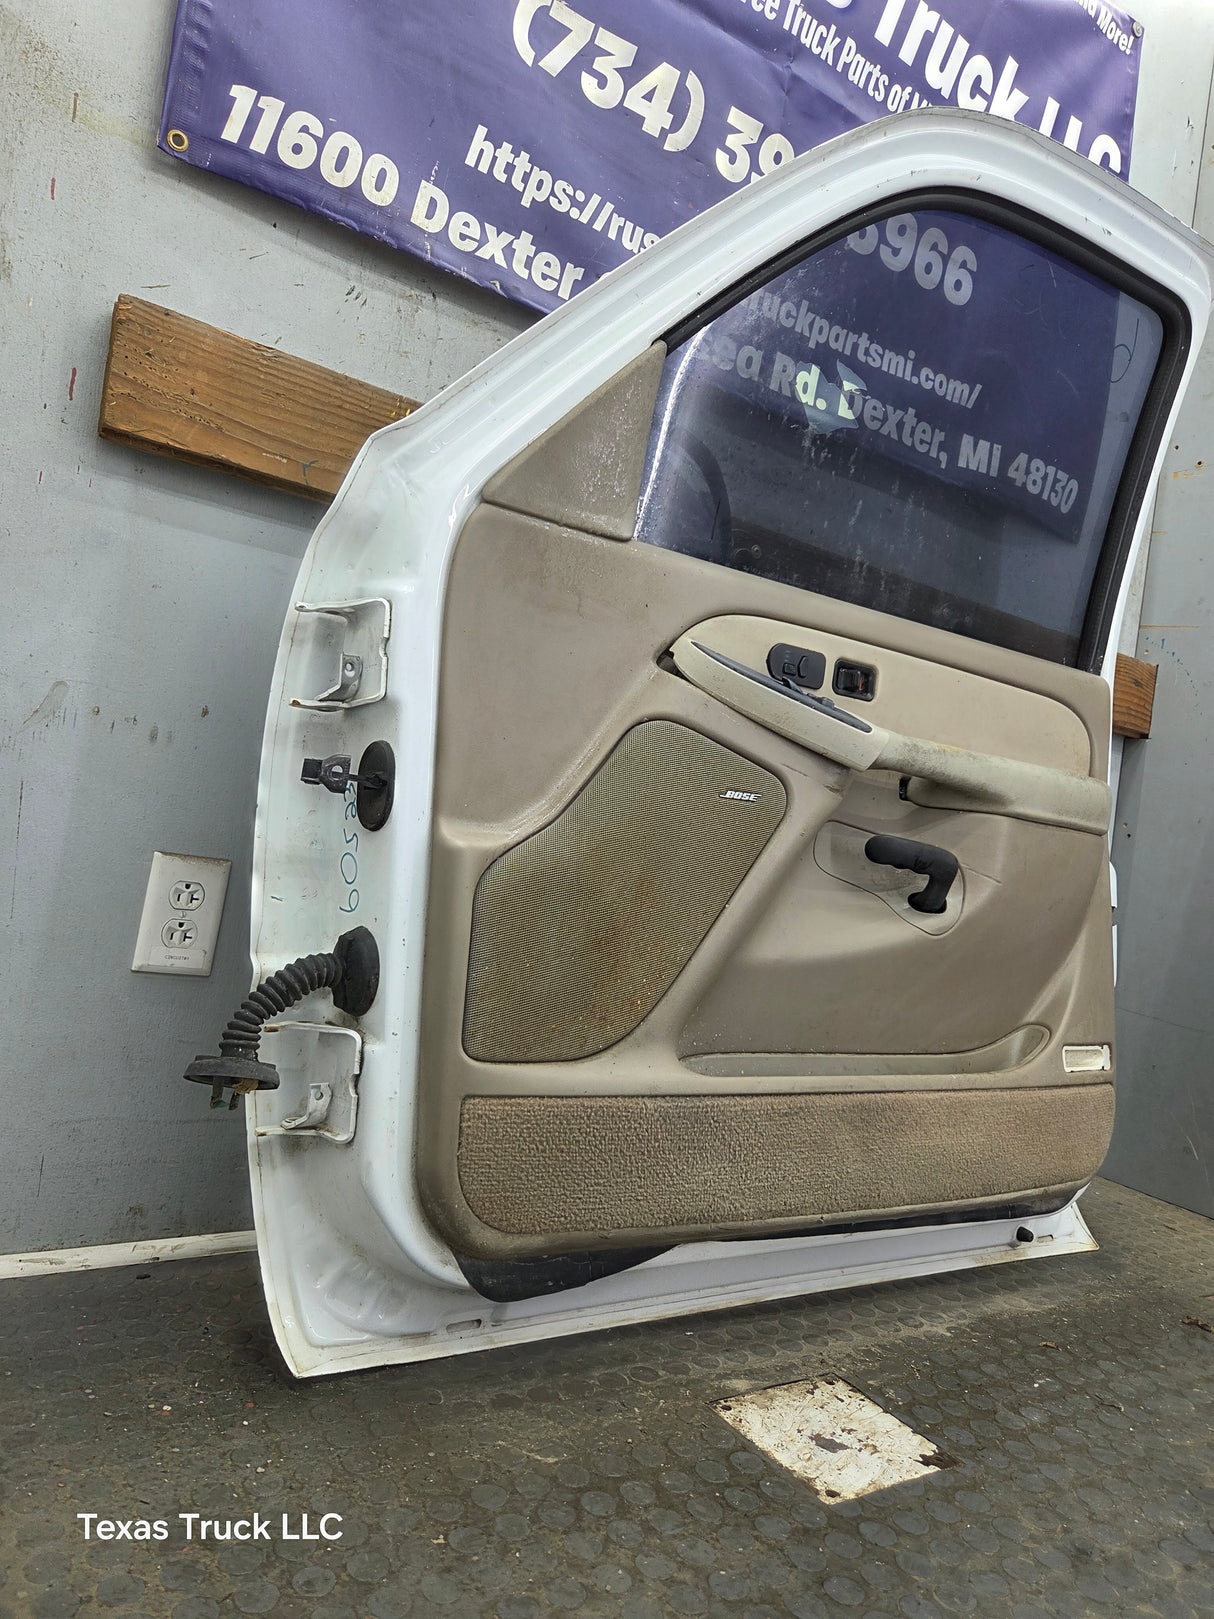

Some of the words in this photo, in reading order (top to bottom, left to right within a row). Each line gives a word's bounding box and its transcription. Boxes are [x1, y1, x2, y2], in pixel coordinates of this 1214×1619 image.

[513, 0, 705, 152] (734)
[783, 0, 841, 66] Truck
[836, 36, 889, 102] Parts
[886, 84, 912, 113] of
[1096, 4, 1135, 55] More!
[220, 84, 400, 206] 11600
[410, 180, 585, 300] Dexter
[769, 352, 827, 411] Rd.
[838, 379, 948, 470] Dexter,
[958, 433, 1002, 478] MI
[1007, 451, 1079, 515] 48130
[719, 790, 762, 803] BOSE
